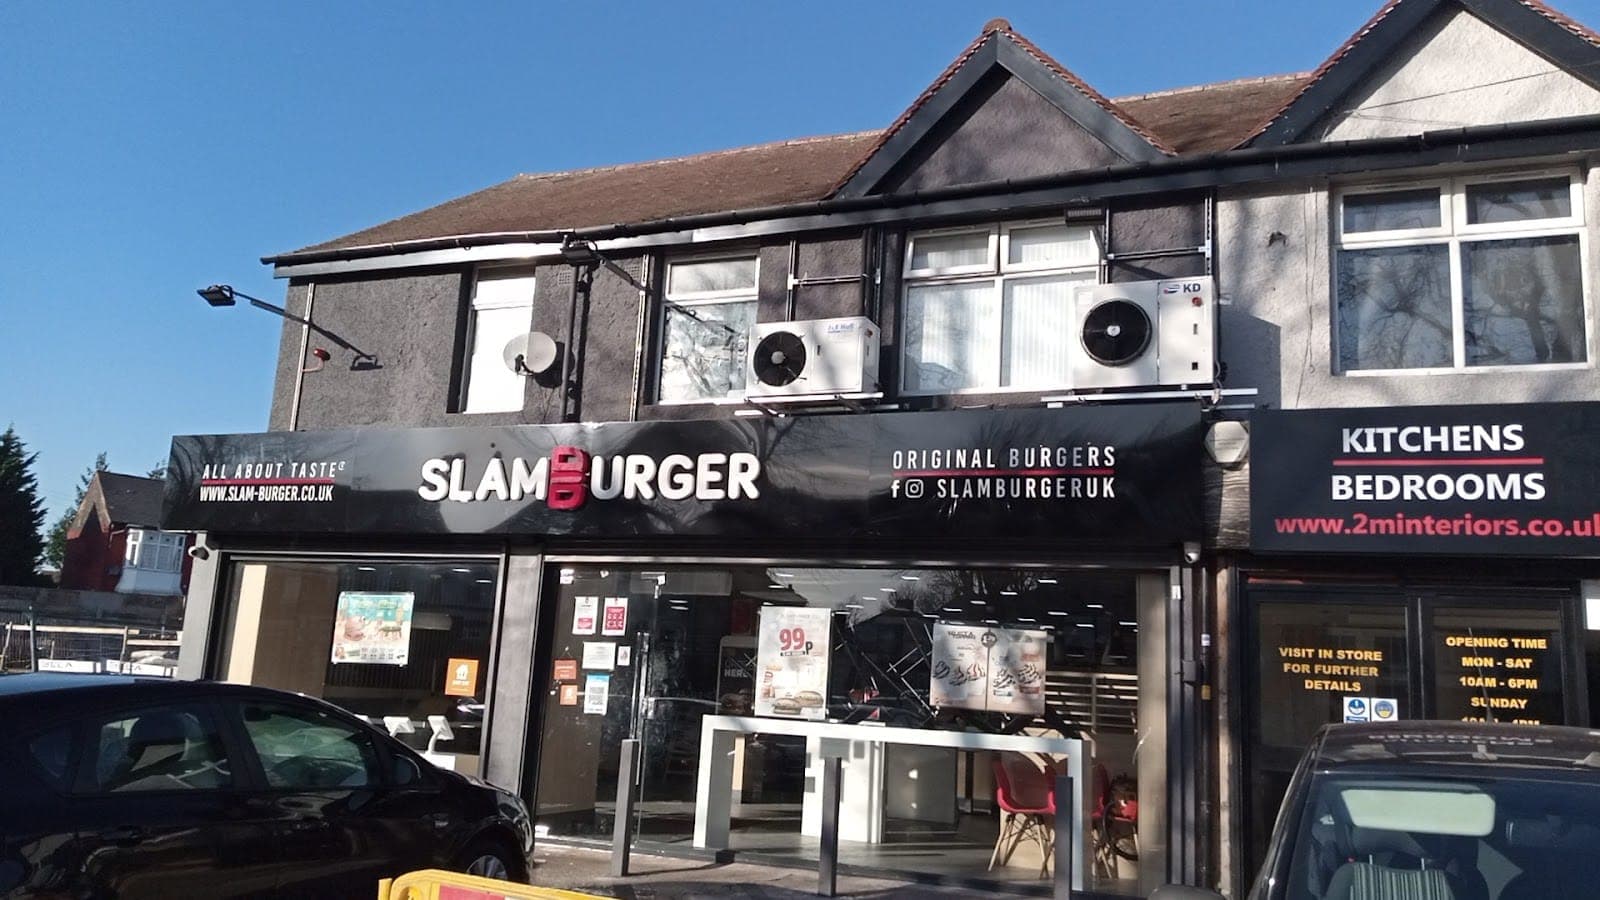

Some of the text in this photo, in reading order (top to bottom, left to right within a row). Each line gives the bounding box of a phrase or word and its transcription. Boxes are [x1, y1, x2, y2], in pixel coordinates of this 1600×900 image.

[1183, 283, 1201, 293] KD
[1342, 424, 1525, 453] KITCHENS
[893, 446, 1115, 470] ORIGINAL BURGERS
[202, 461, 337, 480] ALL ABOUT TASTE
[200, 485, 333, 502] WWW.SLAM-BURGER.CO.UK
[937, 477, 1115, 498] SLAMBURGERUK
[1331, 473, 1546, 501] BEDROOMS
[1446, 636, 1547, 650] OPENING TIME
[1279, 647, 1383, 662] VISIT IN STORE
[1283, 662, 1379, 677] FOR FURTHER
[1462, 656, 1493, 668] MON
[1505, 657, 1533, 669] SAT
[1304, 679, 1362, 692] DETAILS
[1459, 675, 1498, 688] 10AM
[1508, 678, 1538, 690] 6PM
[1470, 696, 1528, 710] SUNDAY
